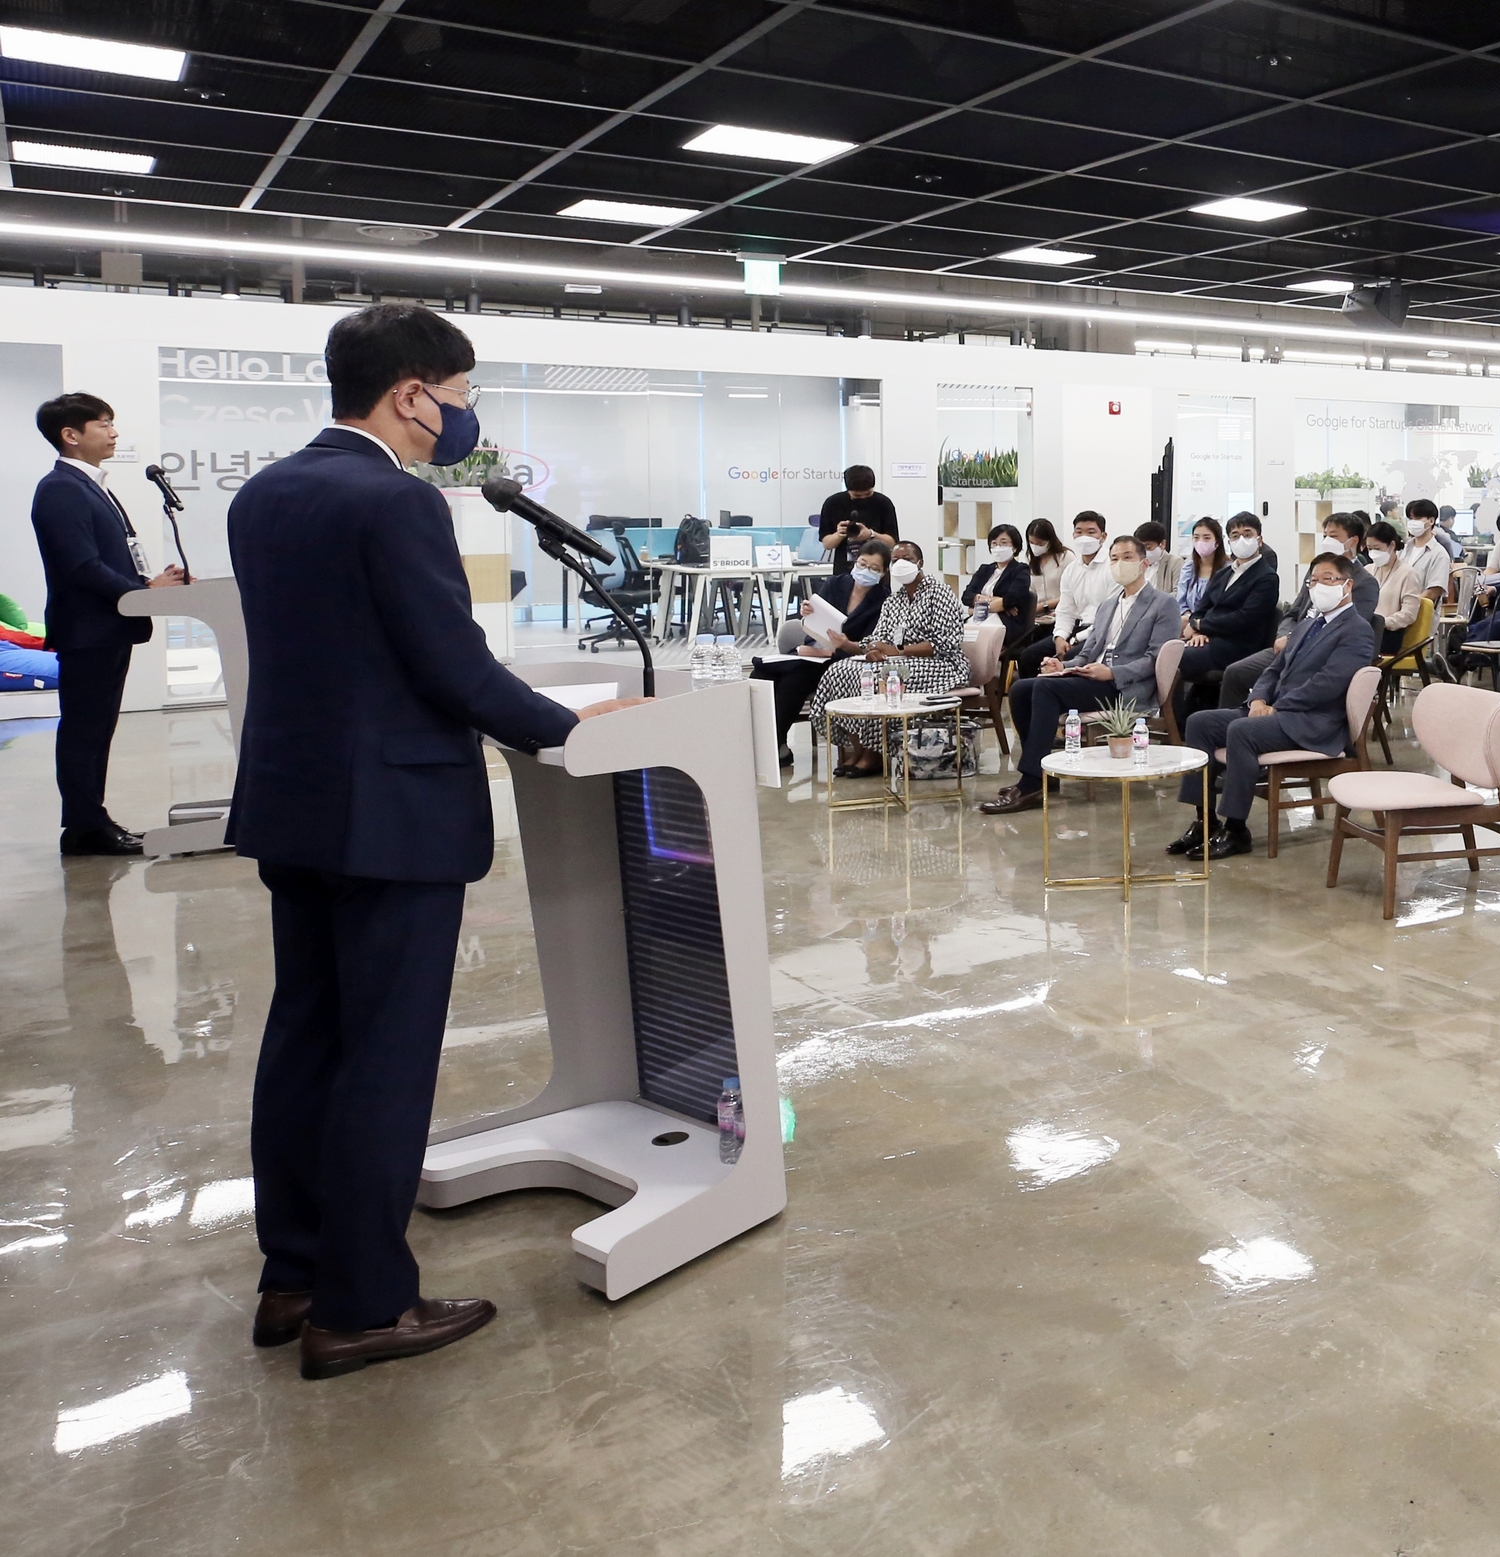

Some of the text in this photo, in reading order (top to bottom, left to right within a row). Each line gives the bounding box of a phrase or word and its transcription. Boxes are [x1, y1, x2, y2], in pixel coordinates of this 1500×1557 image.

[157, 349, 270, 381] Hello
[1306, 414, 1349, 430] Google
[1351, 416, 1367, 429] for
[1368, 416, 1414, 432] Startups
[1190, 452, 1211, 461] Google
[1220, 453, 1243, 461] Startups
[728, 466, 779, 483] Google
[782, 468, 800, 480] for
[951, 476, 994, 488] Startups
